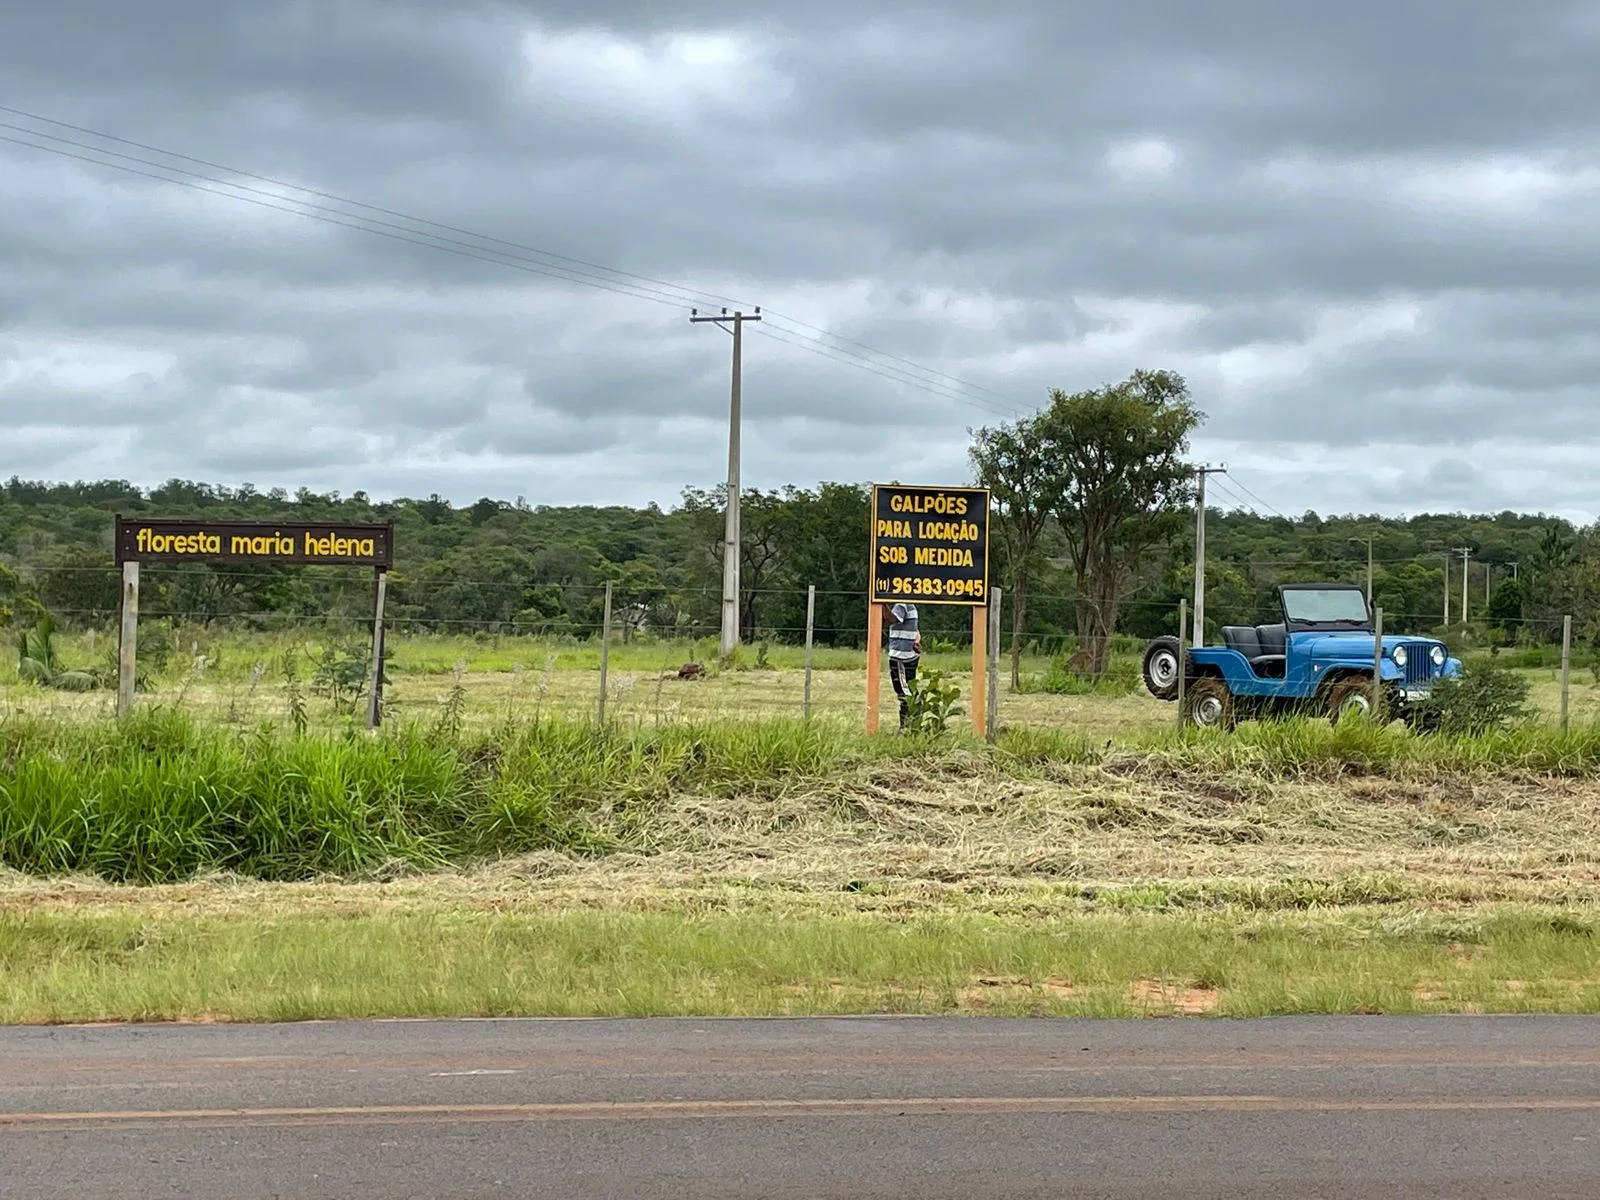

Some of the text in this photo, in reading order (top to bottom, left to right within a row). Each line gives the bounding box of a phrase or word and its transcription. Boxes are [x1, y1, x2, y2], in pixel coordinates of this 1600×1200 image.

[890, 493, 968, 515] GALPÕES
[136, 528, 375, 557] floresta maria helena
[877, 520, 979, 543] PARA LOCAÇÃO
[879, 545, 974, 567] SOB MEDIDA
[875, 577, 890, 592] (11)
